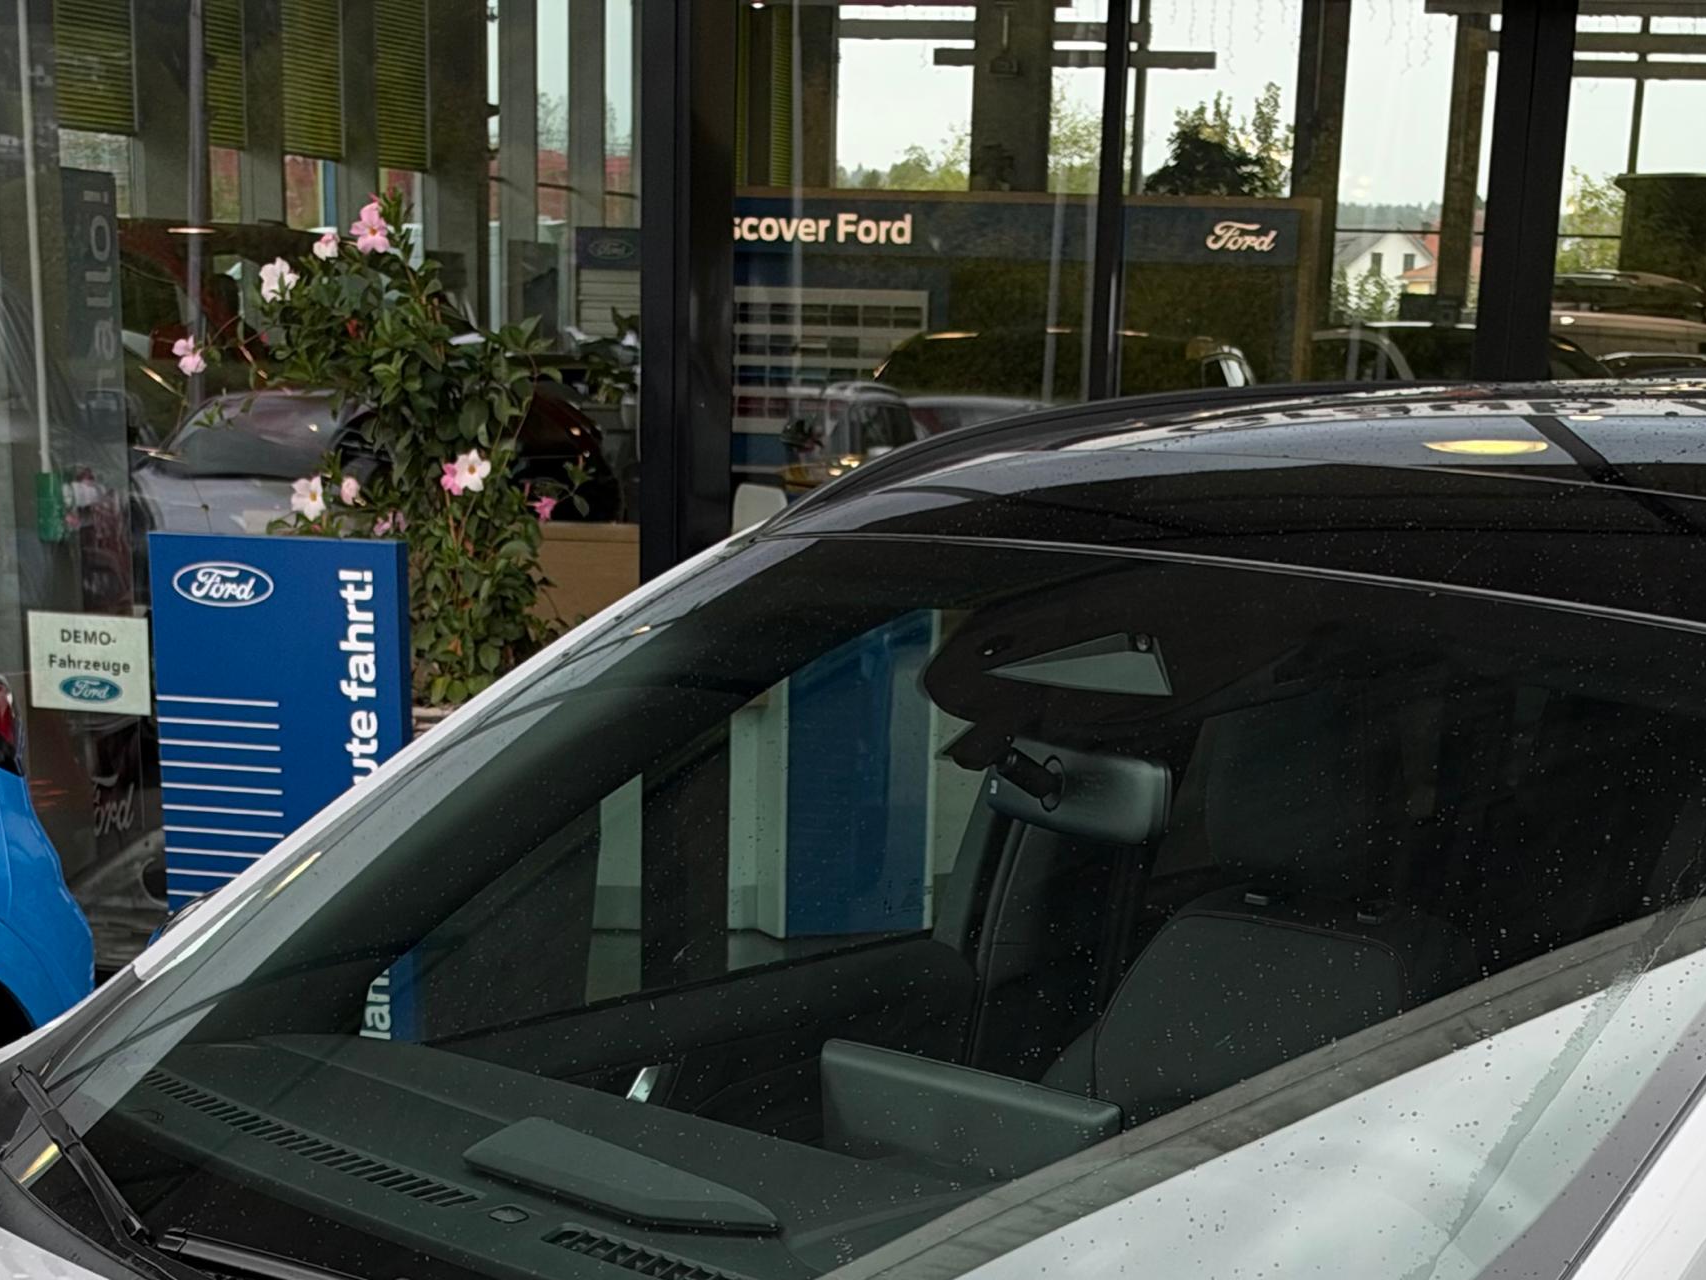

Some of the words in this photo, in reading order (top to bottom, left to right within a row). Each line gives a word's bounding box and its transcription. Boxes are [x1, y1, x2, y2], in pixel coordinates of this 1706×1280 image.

[836, 213, 912, 244] Ford
[1205, 221, 1278, 252] Ford
[191, 568, 256, 601] Ford
[59, 628, 118, 646] DEMO-
[339, 569, 378, 702] fahrt!
[48, 653, 131, 677] Fahrzeuge
[71, 680, 111, 700] Ford
[346, 710, 379, 786] ute
